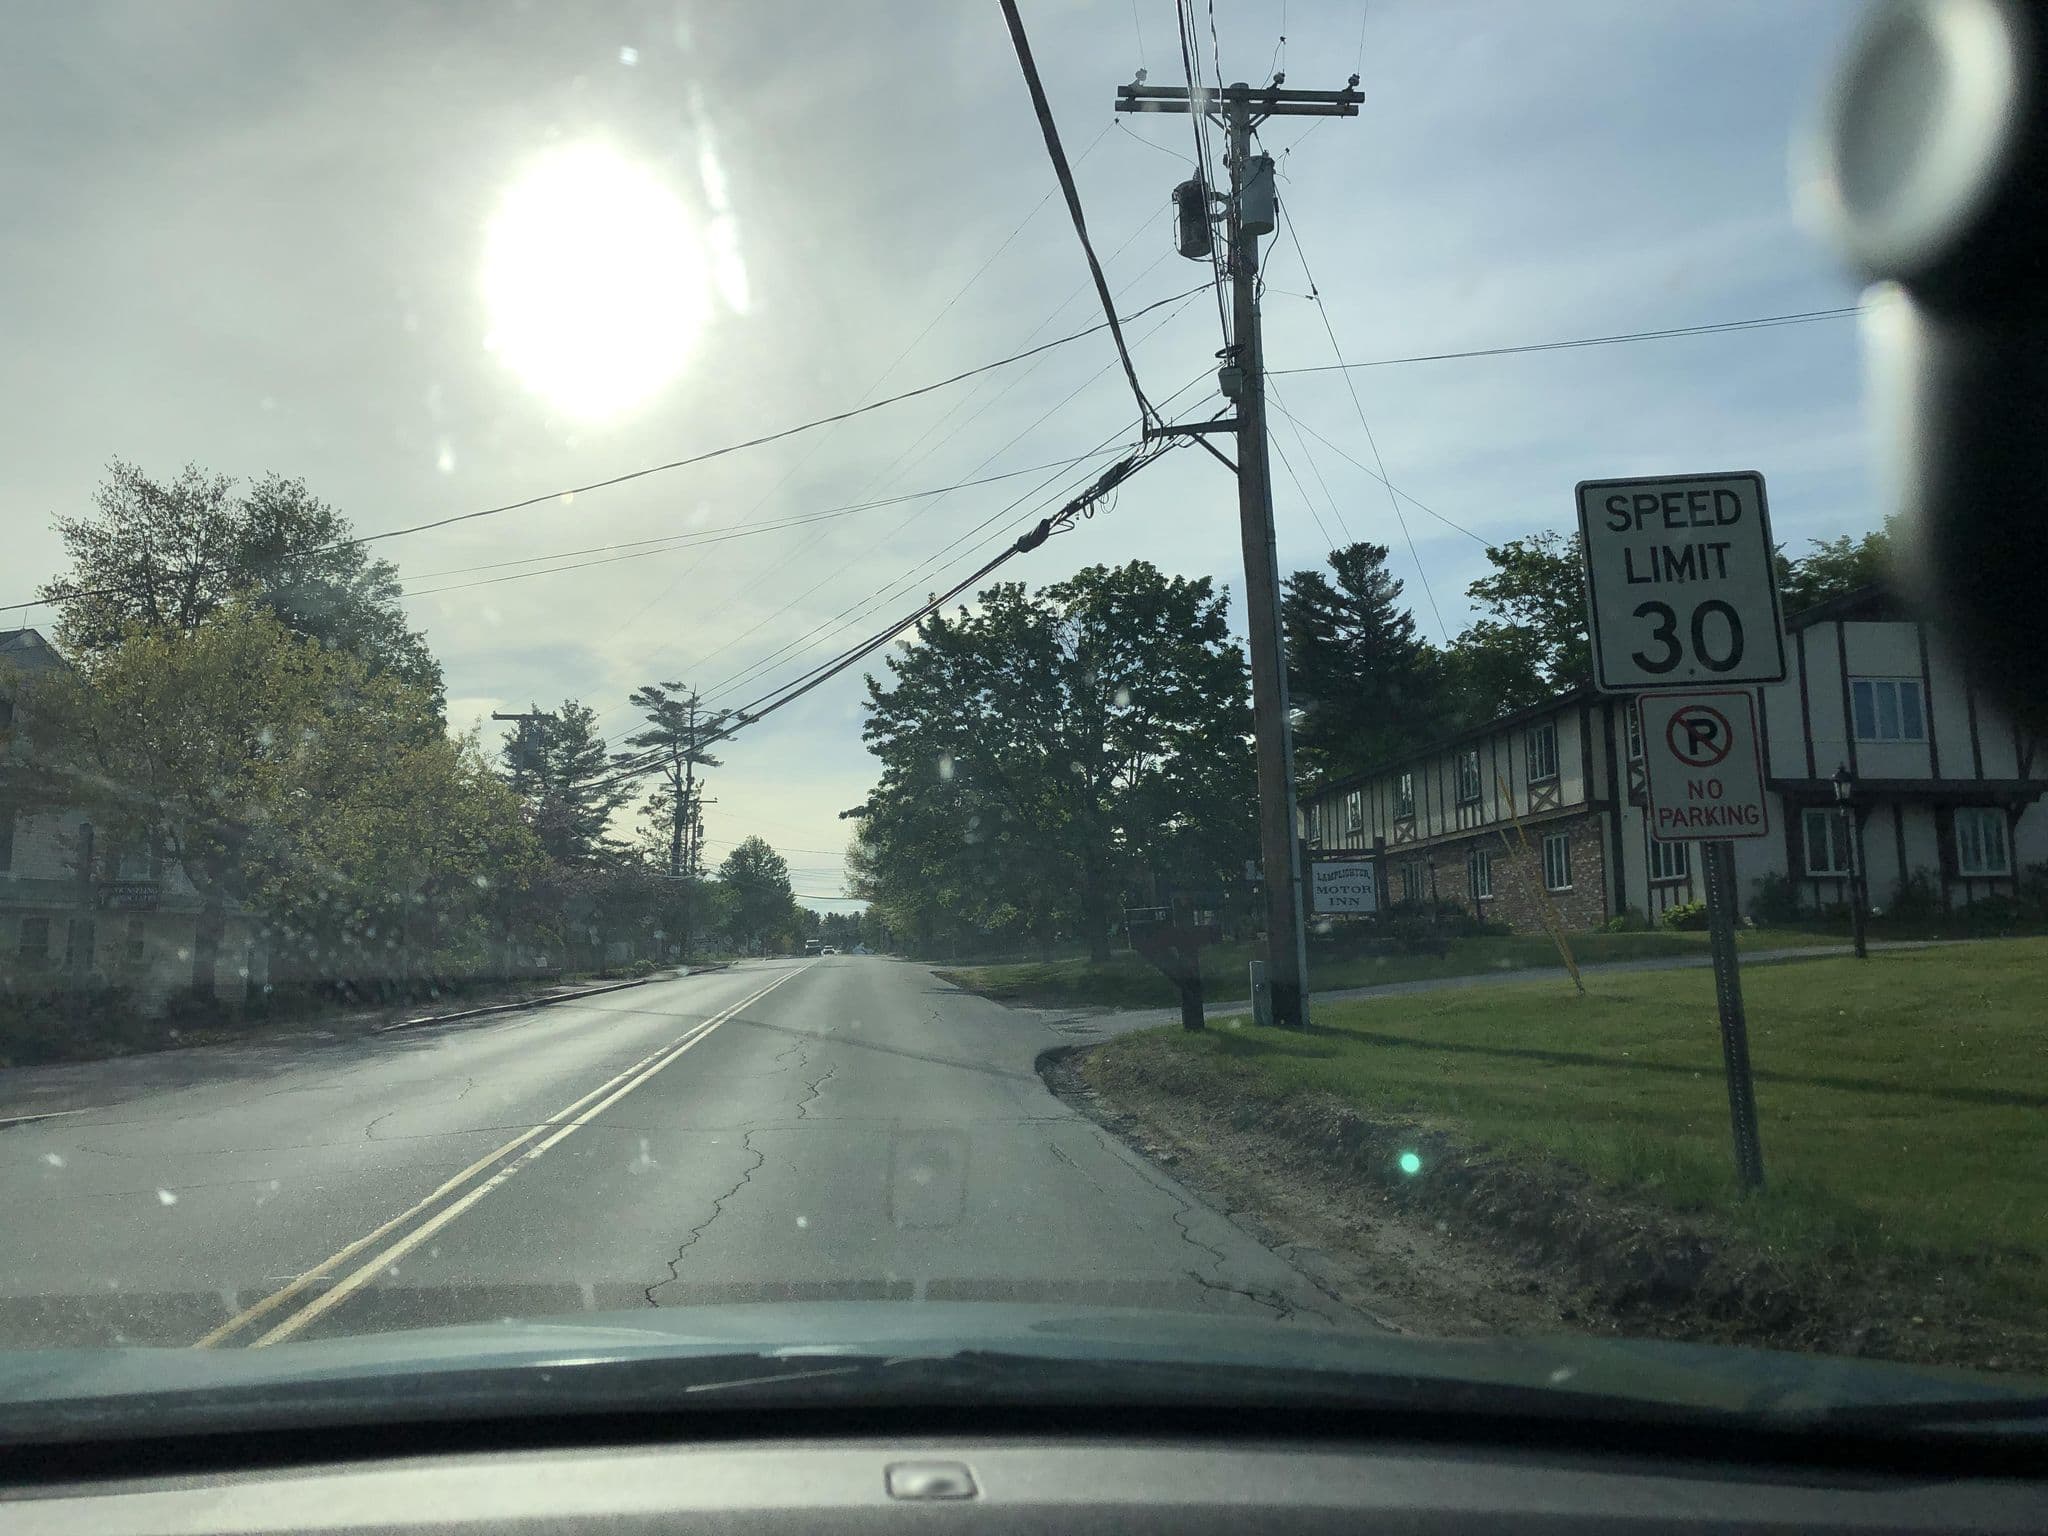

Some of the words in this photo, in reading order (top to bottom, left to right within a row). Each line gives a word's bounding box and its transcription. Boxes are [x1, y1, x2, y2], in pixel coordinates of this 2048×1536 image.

[1605, 489, 1742, 532] SPEED
[1624, 542, 1731, 584] LIMIT
[1632, 600, 1744, 674] 30
[1687, 778, 1724, 800] NO
[1659, 804, 1760, 828] PARKING
[1316, 885, 1372, 895] MOTOR
[1328, 897, 1361, 906] INN
